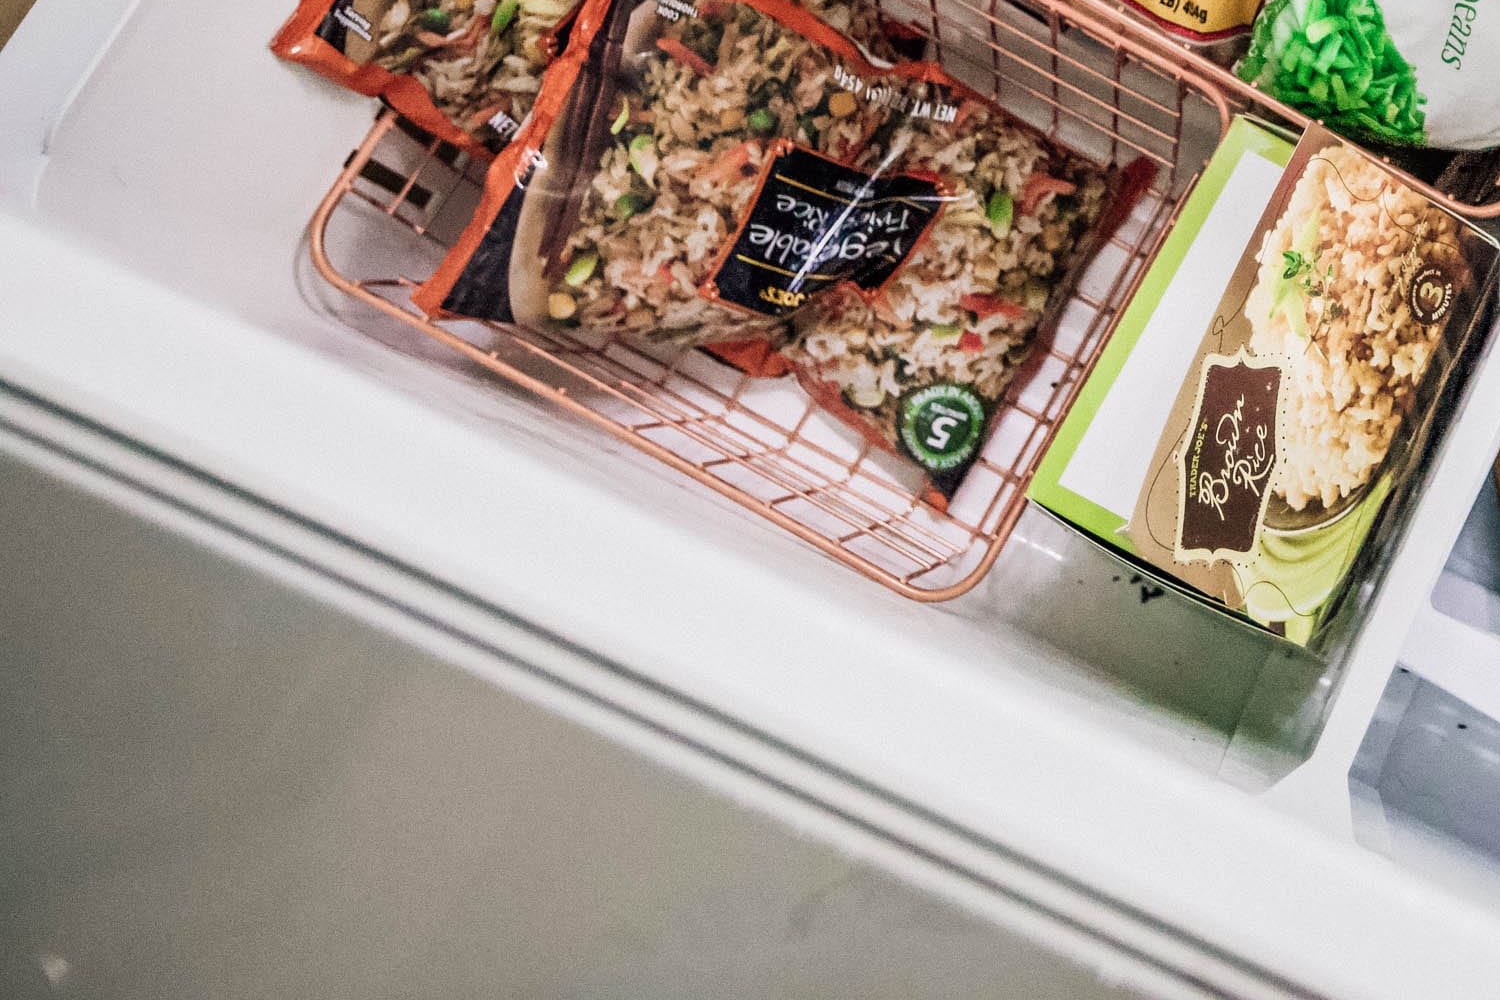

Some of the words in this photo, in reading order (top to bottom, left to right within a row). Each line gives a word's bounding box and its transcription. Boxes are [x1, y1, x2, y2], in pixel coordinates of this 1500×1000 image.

[934, 103, 958, 123] NET
[1420, 281, 1444, 309] 3
[1431, 283, 1453, 321] MINUTES
[926, 416, 959, 450] 5
[1198, 393, 1246, 521] Brown
[1232, 423, 1276, 497] Rice
[1189, 455, 1201, 498] TRADER
